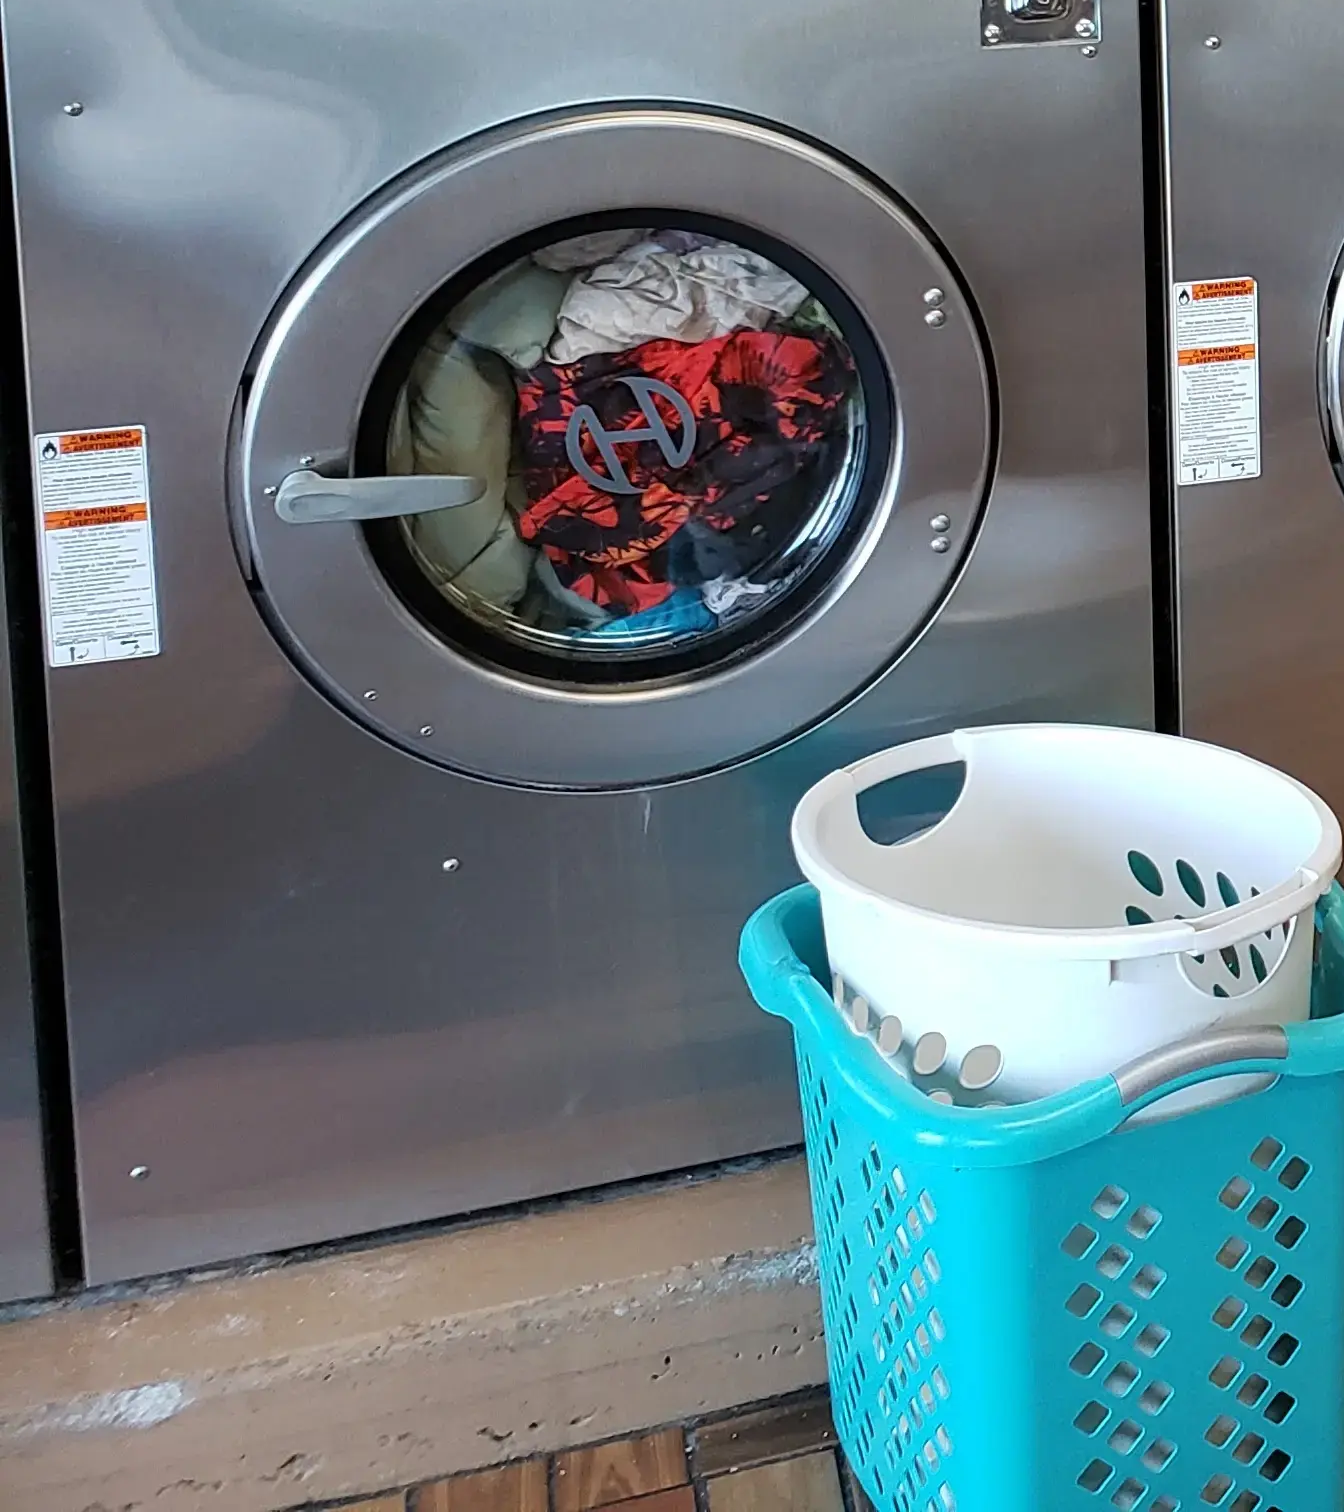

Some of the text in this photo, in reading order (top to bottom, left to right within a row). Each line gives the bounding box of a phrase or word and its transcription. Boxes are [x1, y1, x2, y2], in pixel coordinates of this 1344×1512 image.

[1206, 281, 1247, 292] WARNING
[1200, 346, 1240, 356] WARNING
[79, 431, 132, 443] WARNING
[74, 505, 126, 518] WARNING
